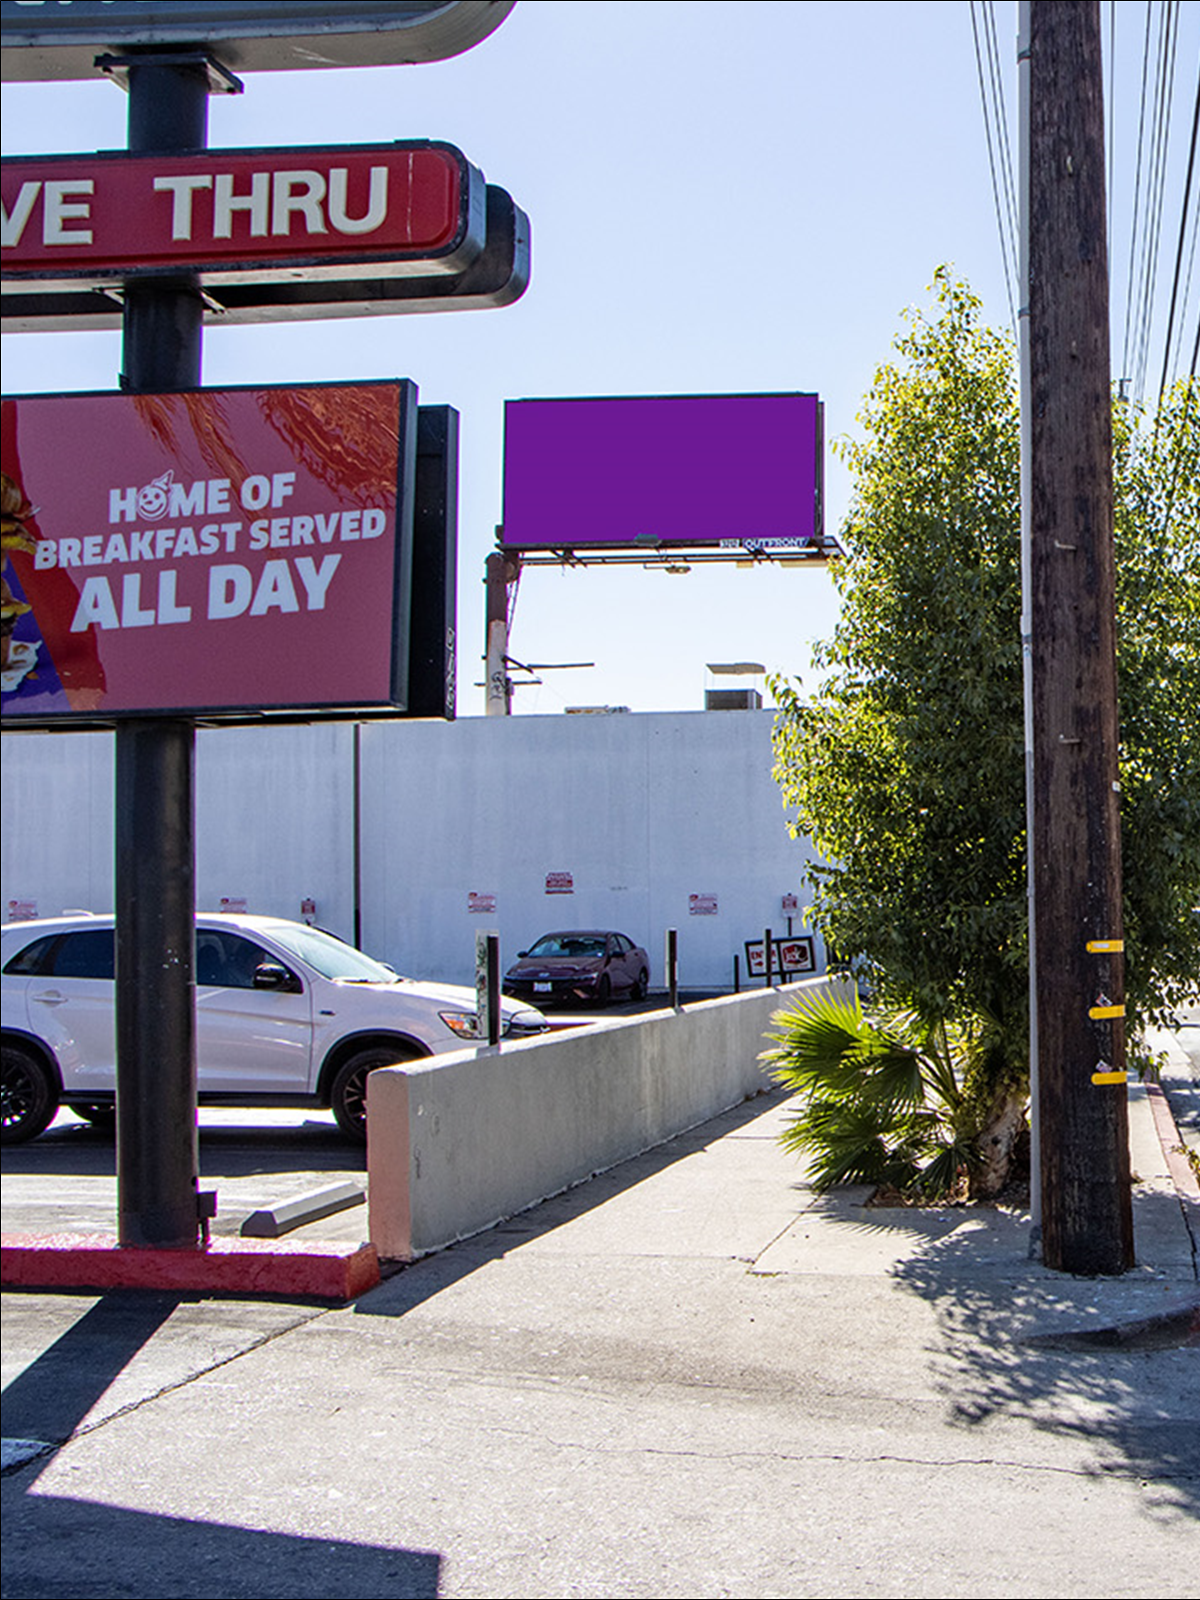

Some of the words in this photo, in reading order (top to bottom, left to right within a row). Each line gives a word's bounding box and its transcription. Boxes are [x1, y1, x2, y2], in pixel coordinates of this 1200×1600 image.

[153, 166, 389, 241] THRU
[240, 472, 297, 511] OF
[34, 522, 242, 571] BREAKFAST
[249, 509, 387, 550] SERVED
[745, 537, 807, 548] OUTFRONT
[70, 569, 192, 633] ALL
[207, 554, 343, 620] DAY
